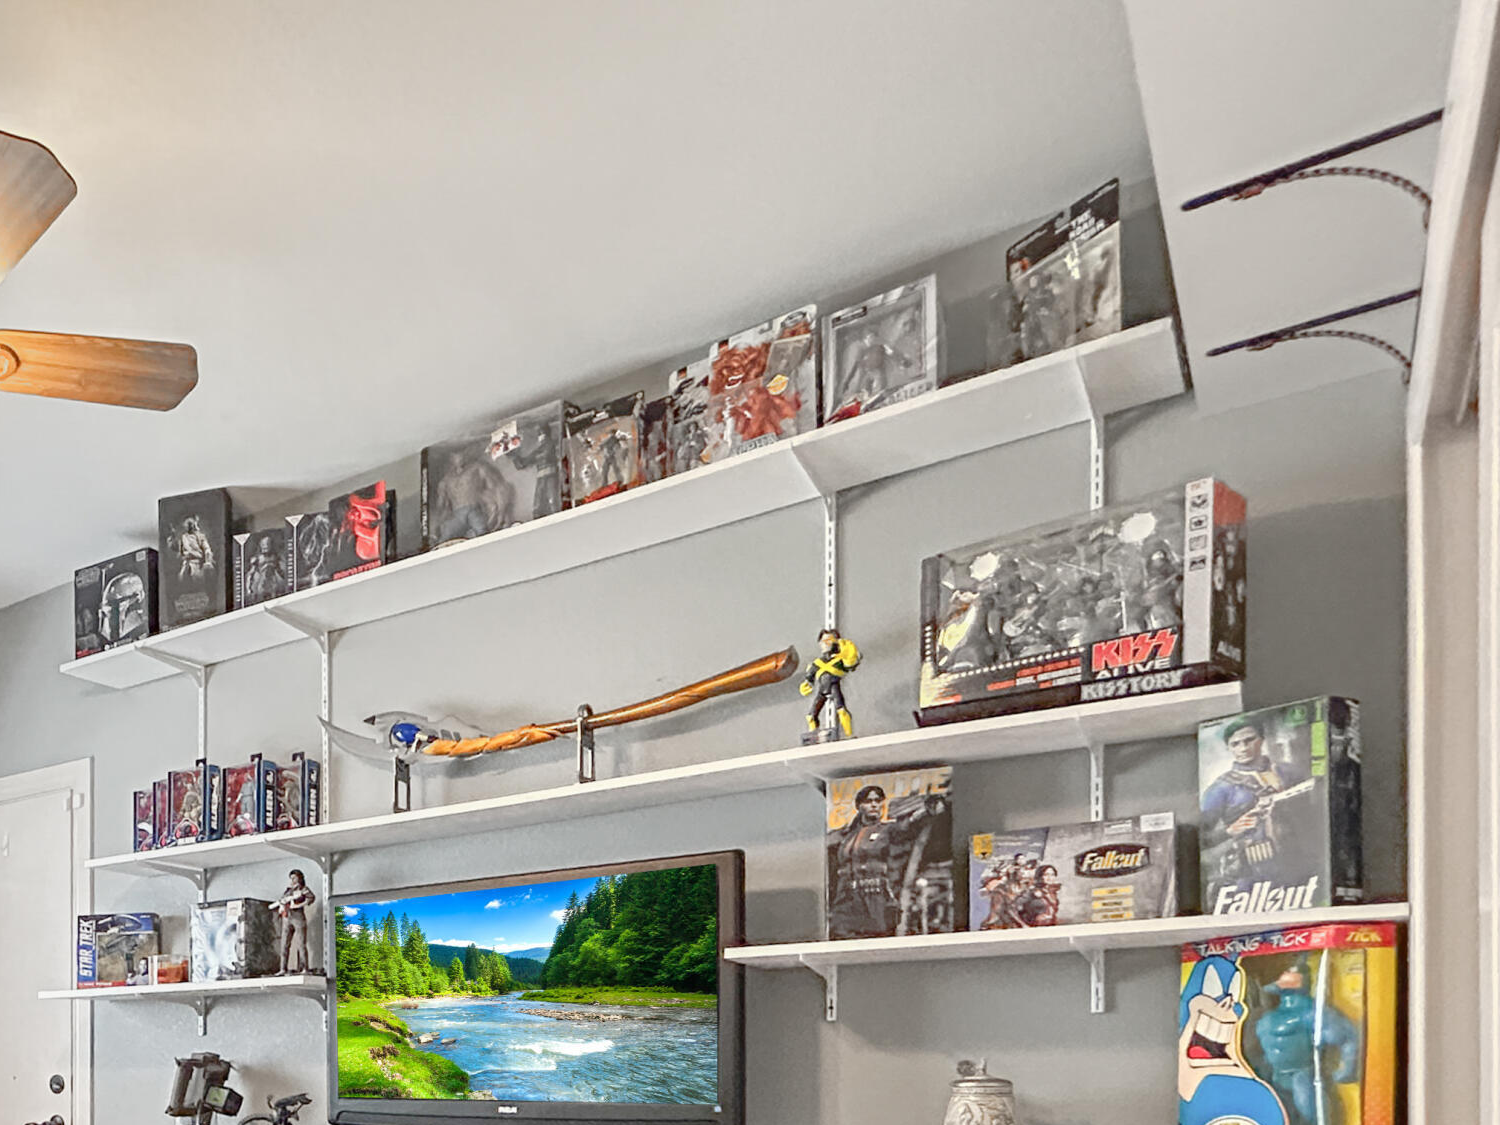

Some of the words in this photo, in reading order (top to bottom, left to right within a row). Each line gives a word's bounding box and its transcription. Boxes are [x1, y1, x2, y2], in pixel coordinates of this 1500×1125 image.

[1092, 628, 1178, 673] KISS
[1080, 666, 1186, 701] KISSTORY
[1082, 848, 1147, 873] Fallout
[1214, 873, 1319, 916] Fallout
[79, 918, 95, 946] TREK
[1198, 934, 1262, 956] TALKING
[1270, 931, 1308, 949] TICK
[79, 949, 94, 977] STAR
